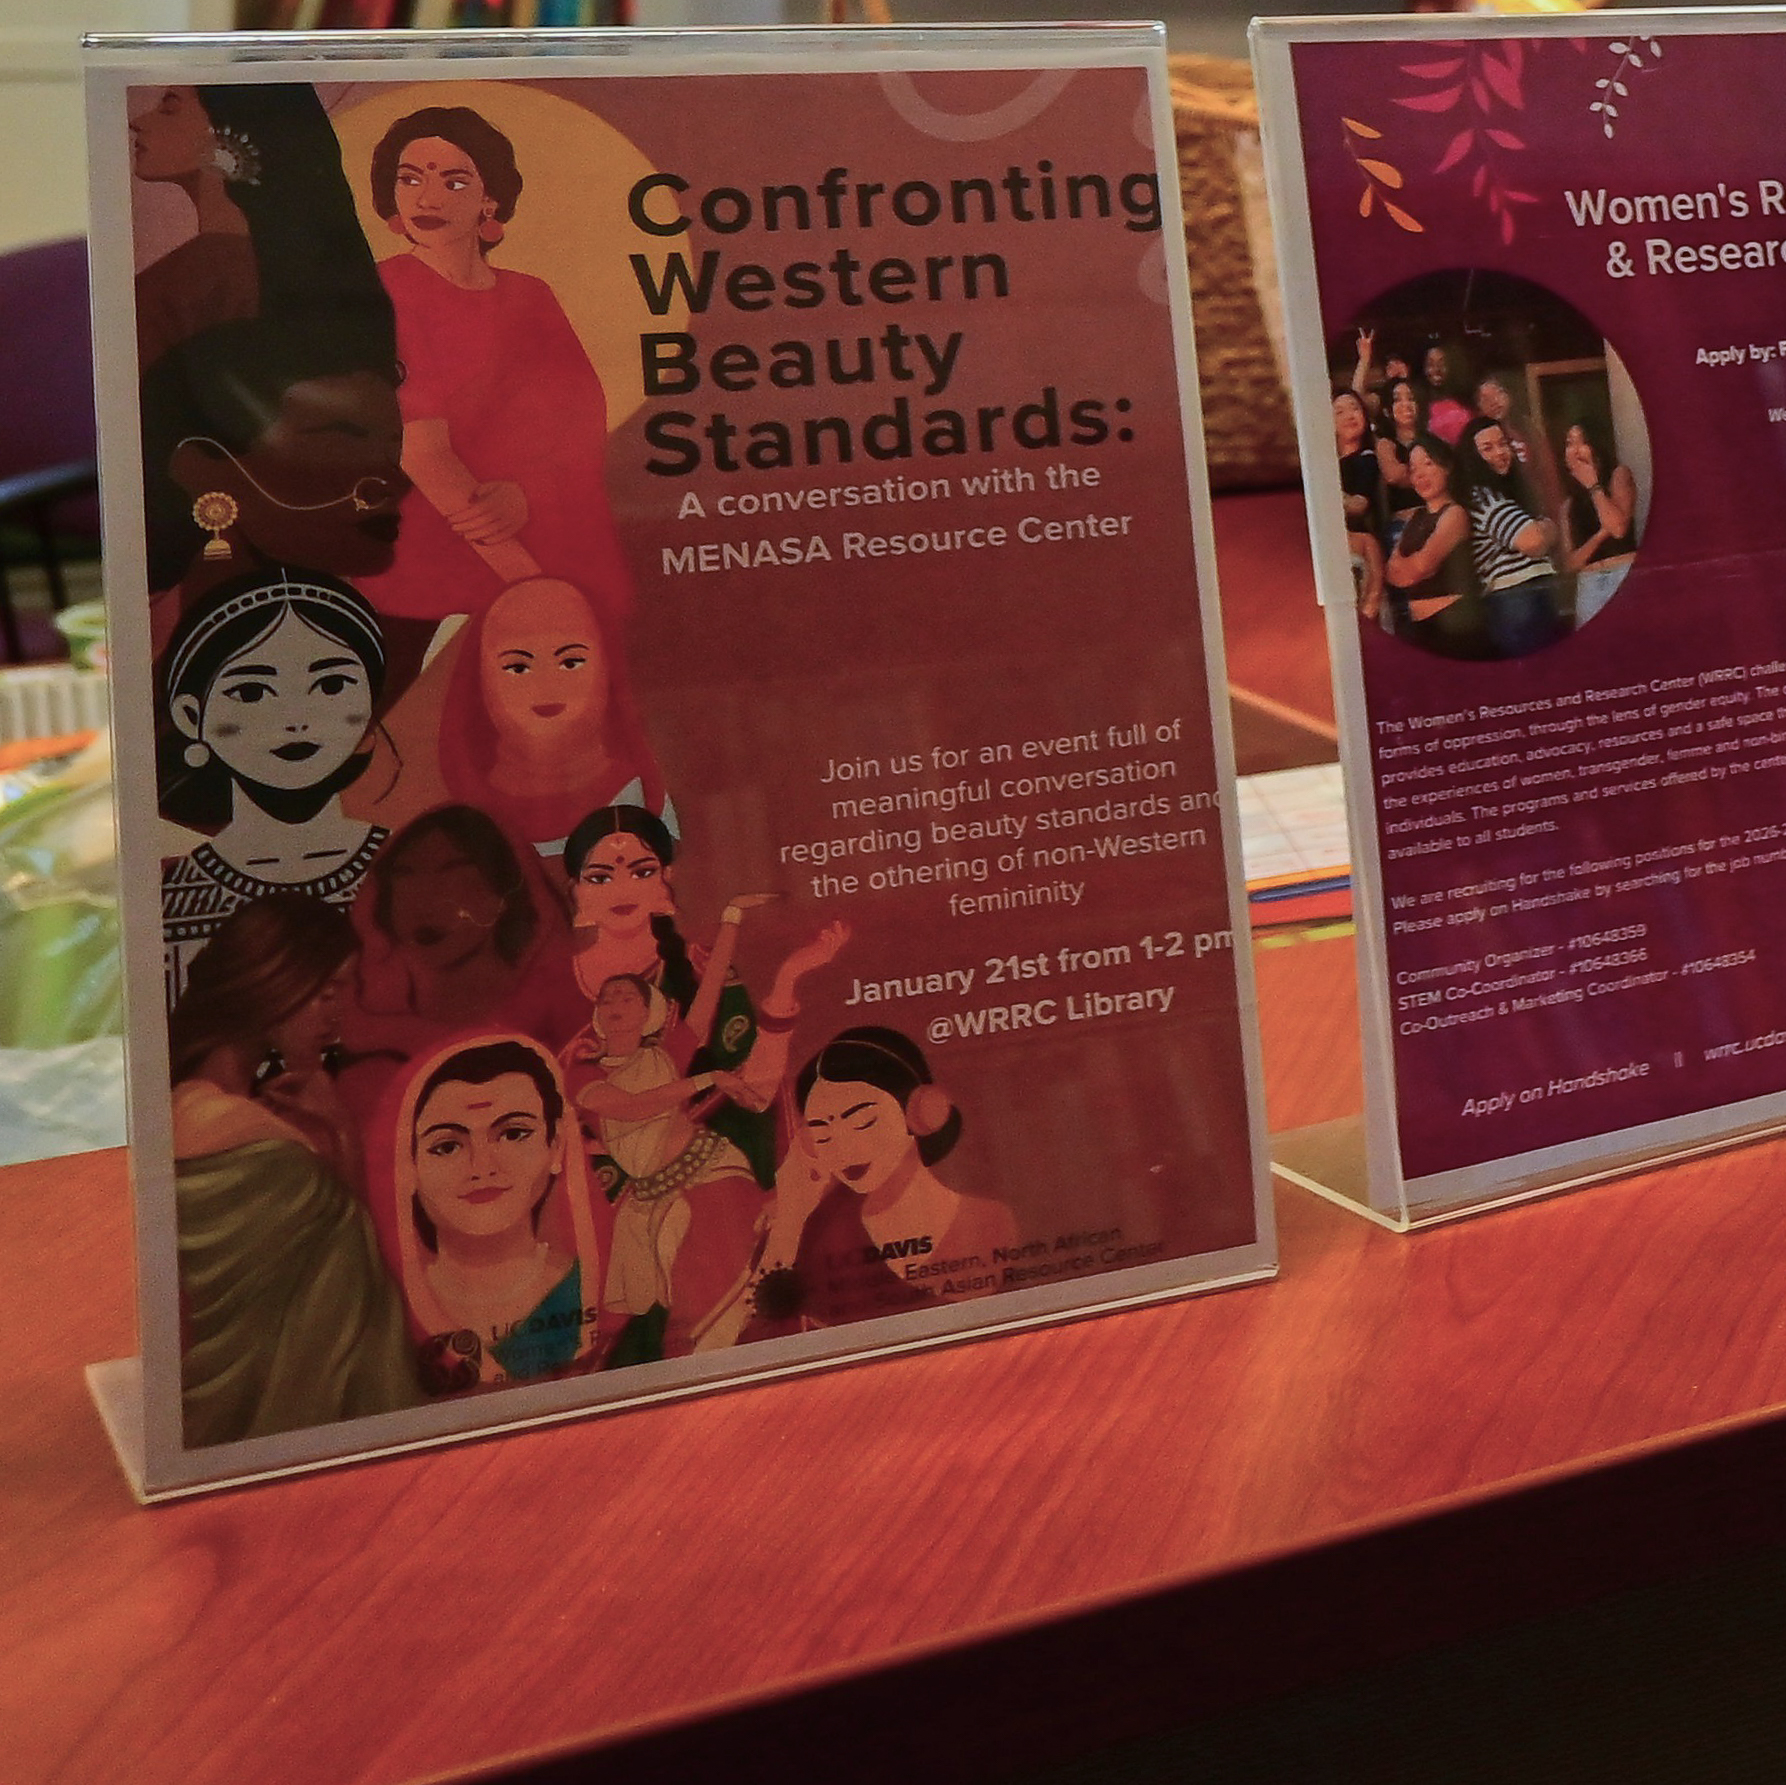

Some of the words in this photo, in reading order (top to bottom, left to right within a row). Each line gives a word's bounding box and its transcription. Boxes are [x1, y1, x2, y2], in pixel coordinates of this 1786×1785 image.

[626, 160, 1163, 237] Confronting
[1564, 182, 1749, 228] Women's
[628, 249, 1010, 315] Western
[1605, 240, 1634, 278] &
[639, 323, 963, 397] Beauty
[1695, 347, 1747, 365] Apply
[1748, 341, 1776, 362] by:
[645, 386, 1135, 477] Standards:
[677, 493, 705, 520] A
[717, 475, 952, 517] conversation
[961, 468, 1035, 497] with
[1045, 464, 1102, 490] the
[661, 537, 833, 576] MENASA
[842, 521, 1008, 560] Resource
[1017, 512, 1133, 544] Center
[1376, 721, 1404, 734] The
[1408, 710, 1476, 729] Women's
[1479, 701, 1552, 720] Resources
[1556, 692, 1581, 707] and
[1585, 681, 1648, 702] Research
[1650, 675, 1695, 693] Center
[820, 756, 880, 784] Join
[890, 754, 922, 774] us
[932, 746, 969, 770] for
[979, 744, 1012, 764] an
[1022, 731, 1099, 759] event
[1107, 723, 1148, 748] full
[1155, 718, 1182, 742] of
[831, 777, 991, 820] meaningful
[999, 759, 1177, 799] conversation
[780, 826, 922, 866] regarding
[930, 812, 1028, 845] beauty
[1036, 795, 1171, 832] standards
[1388, 838, 1453, 860] available
[1456, 834, 1472, 848] to
[1475, 831, 1491, 845] all
[1495, 820, 1559, 841] students.
[811, 873, 859, 899] the
[869, 855, 989, 891] othering
[998, 848, 1025, 873] of
[1033, 826, 1207, 868] non-Western
[949, 879, 1086, 917] femininity
[845, 965, 976, 1006] January
[984, 951, 1050, 986] 21st
[1058, 941, 1131, 973] from
[1139, 932, 1185, 960] 1-2
[1396, 955, 1482, 986] Community
[1484, 944, 1555, 969] Organizer
[1398, 990, 1443, 1011] STEM
[1444, 966, 1557, 1002] Co-Coordinator
[926, 998, 1058, 1044] @WRRC
[1066, 984, 1176, 1021] Library
[1399, 1004, 1495, 1036] Co-Outreach
[1499, 1001, 1510, 1016] &
[1511, 986, 1584, 1014] Marketing
[1587, 968, 1670, 997] Coordinator
[1461, 1091, 1515, 1117] Apply
[1519, 1086, 1544, 1103] on
[1547, 1060, 1651, 1098] Handshake
[993, 1238, 1051, 1264] North
